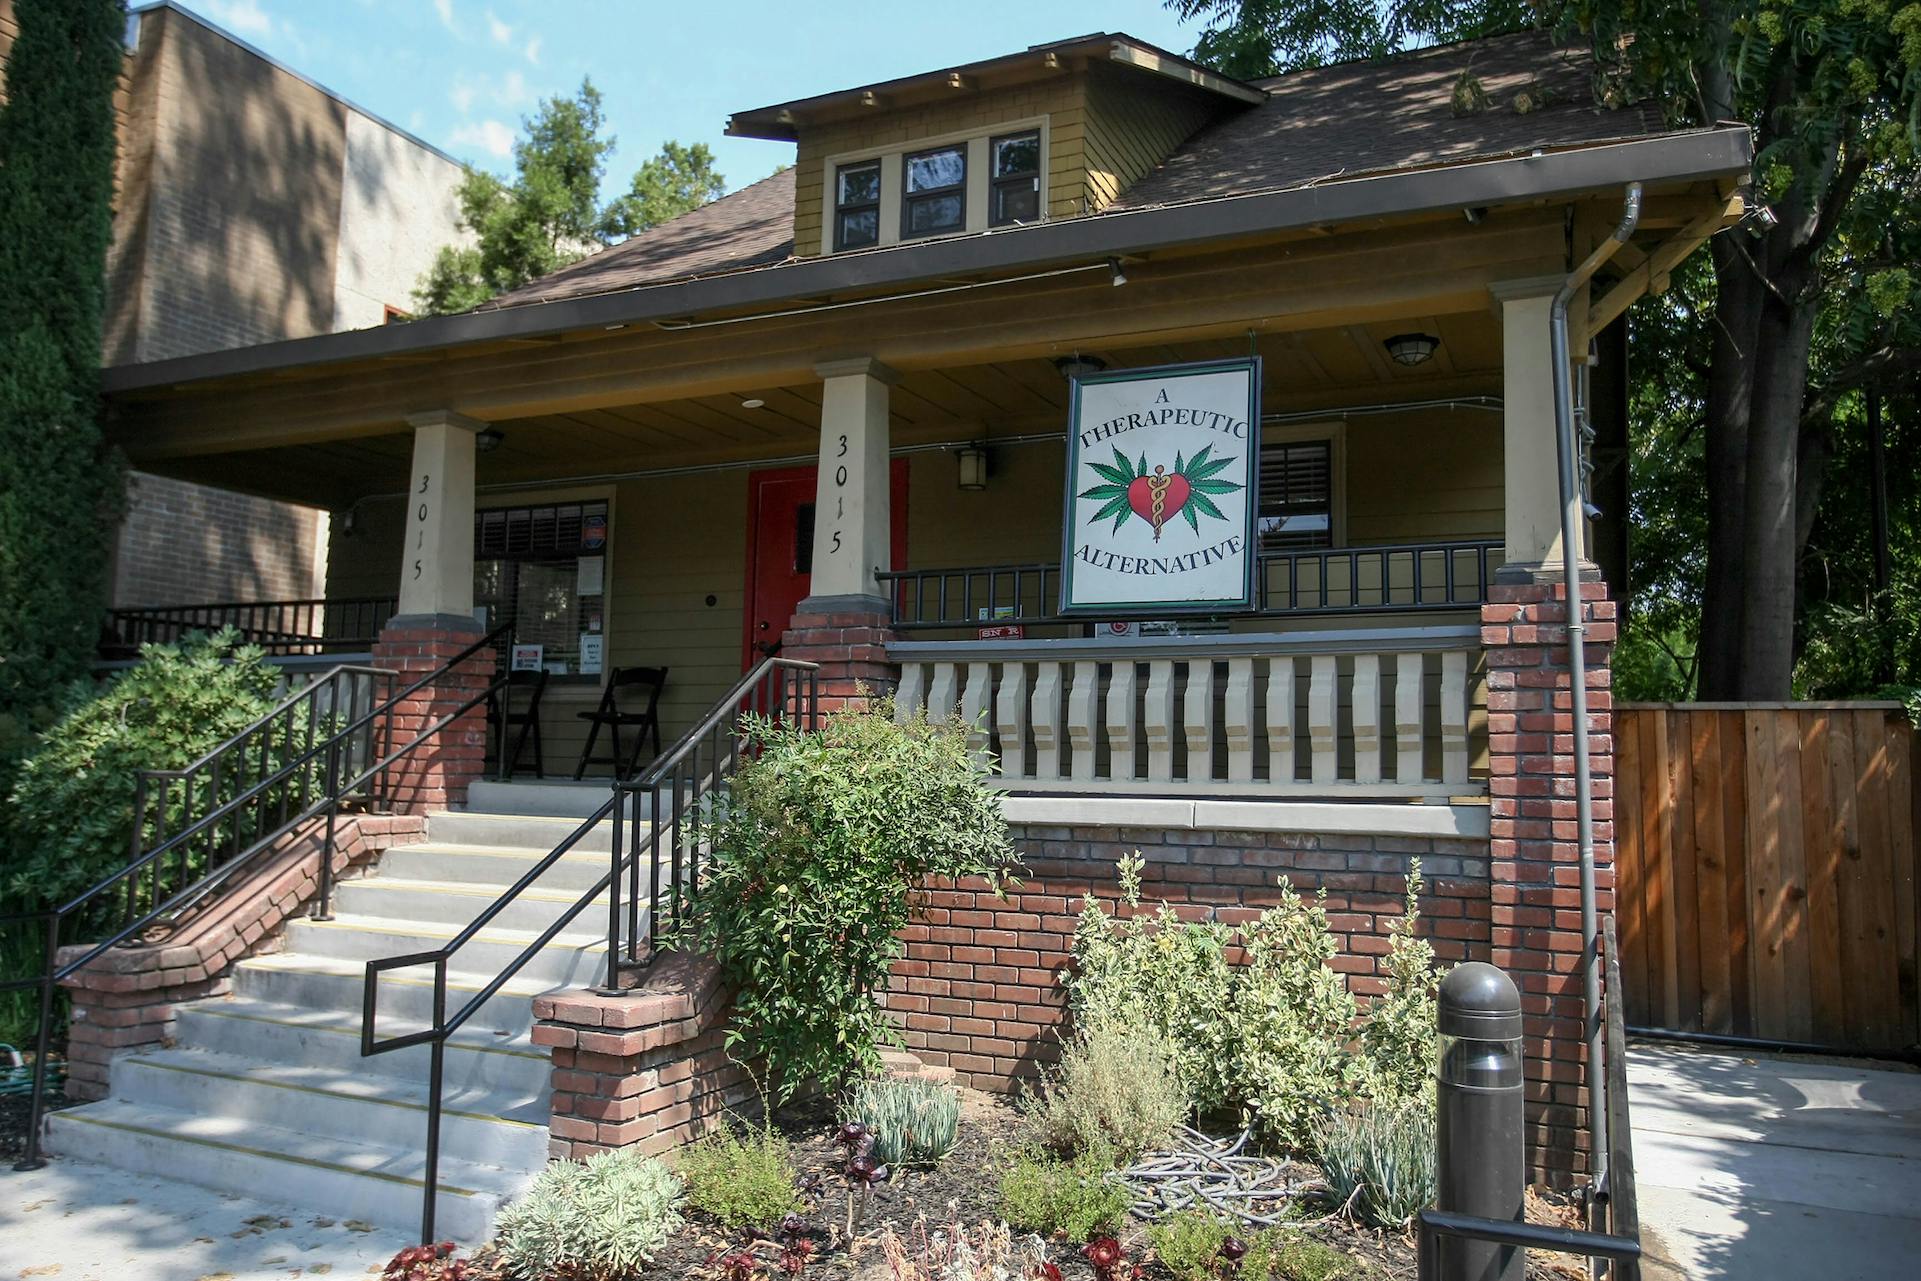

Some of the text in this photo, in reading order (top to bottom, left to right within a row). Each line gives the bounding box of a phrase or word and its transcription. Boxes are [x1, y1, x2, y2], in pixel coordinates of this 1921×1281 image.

[1155, 388, 1170, 404] A
[1079, 408, 1249, 449] THERAPEUTIC
[830, 434, 848, 554] 3015
[414, 474, 430, 581] 3015
[1074, 535, 1246, 576] ALTERNATIVE
